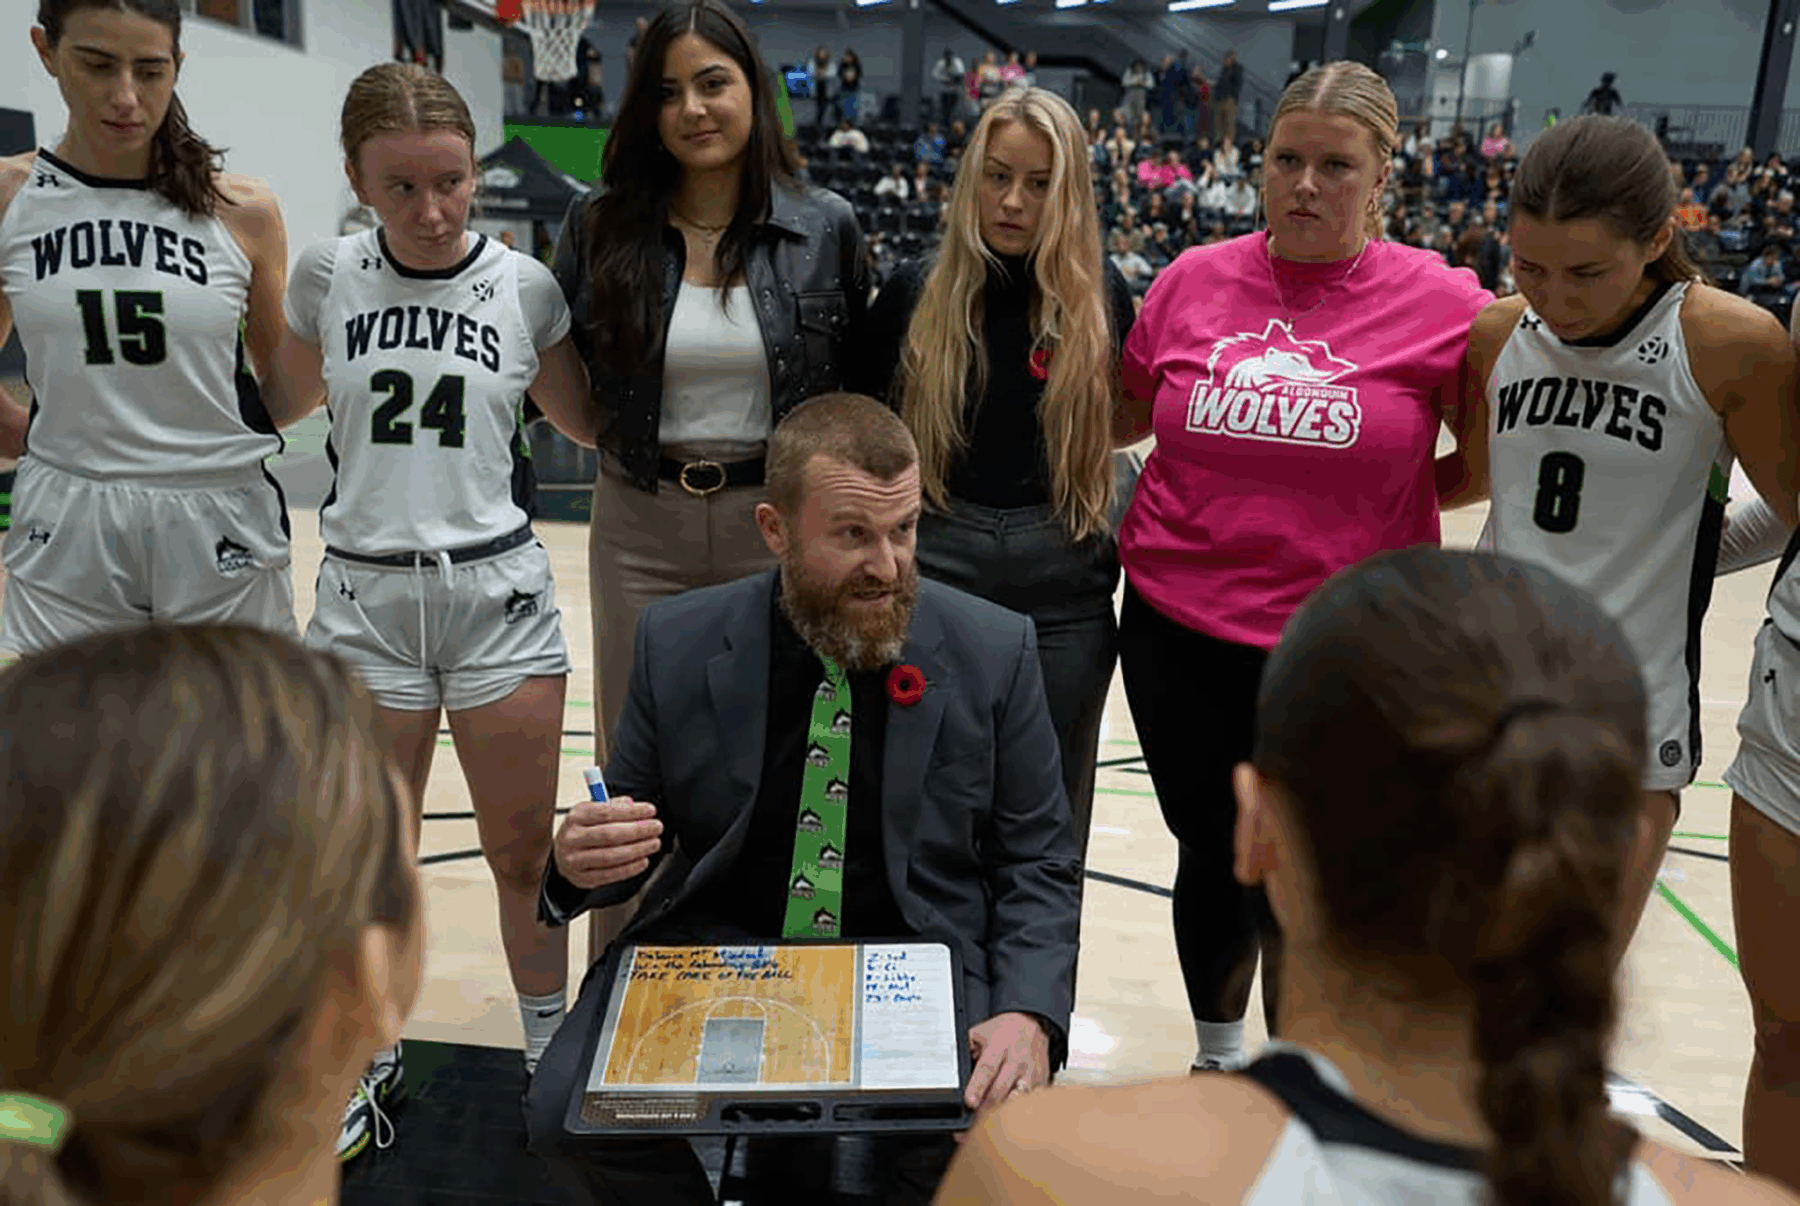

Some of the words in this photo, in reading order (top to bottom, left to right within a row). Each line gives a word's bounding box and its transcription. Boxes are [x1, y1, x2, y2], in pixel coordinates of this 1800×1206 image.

[31, 219, 208, 285] WOLVES
[76, 289, 167, 365] 15
[345, 305, 500, 373] WOLVES
[370, 369, 466, 448] 24
[1191, 386, 1355, 442] WOLVES
[1496, 377, 1667, 452] WOLVES
[1533, 451, 1585, 534] 8
